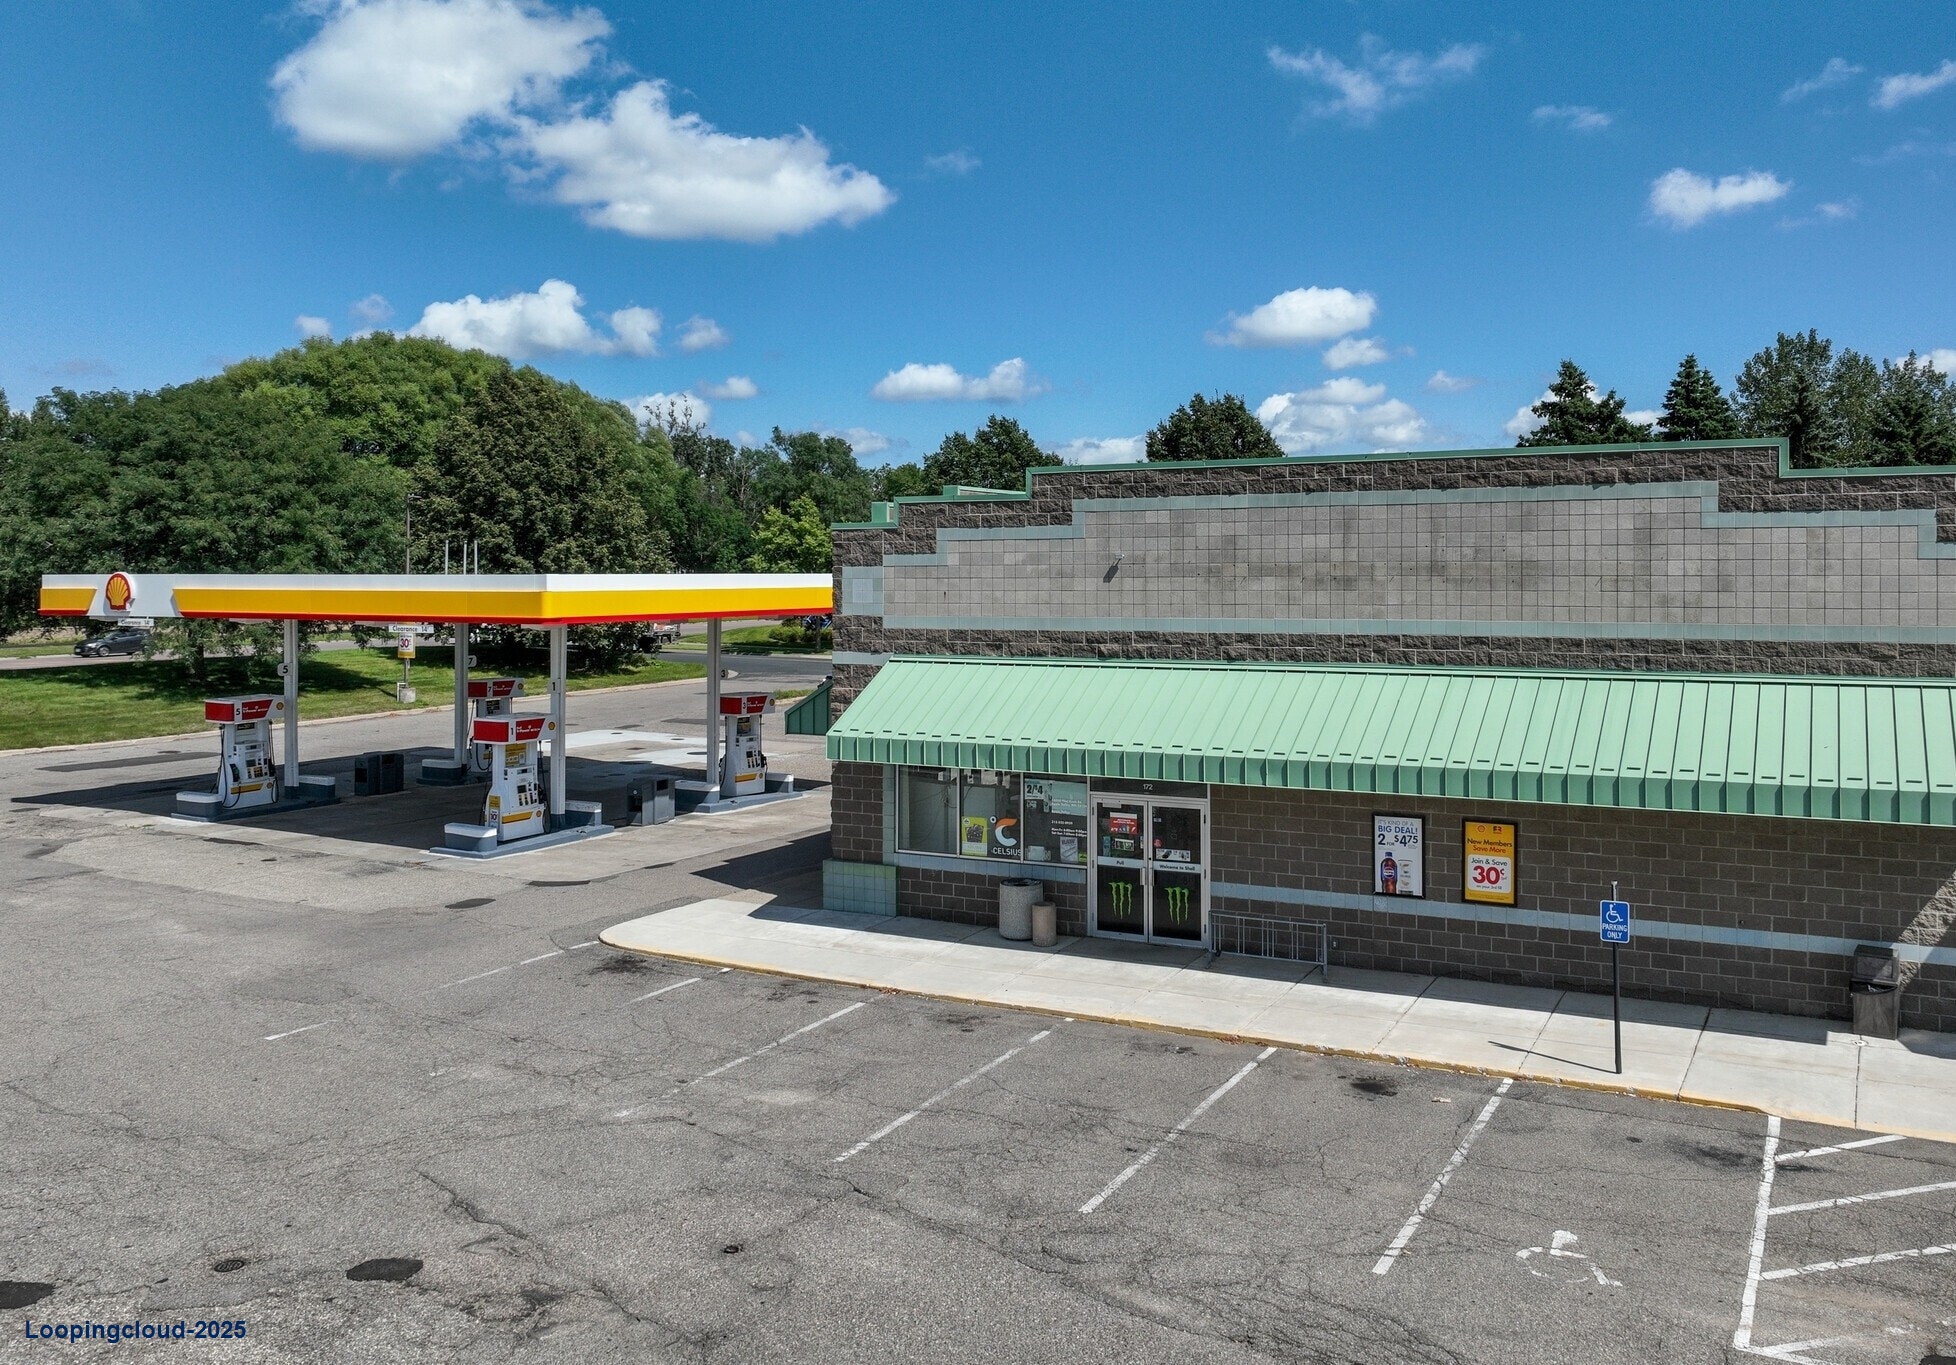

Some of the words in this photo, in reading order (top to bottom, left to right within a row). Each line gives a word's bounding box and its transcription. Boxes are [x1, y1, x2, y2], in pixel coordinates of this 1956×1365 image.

[282, 665, 288, 674] 5
[552, 682, 555, 691] 1
[1378, 834, 1386, 845] 2
[992, 848, 1021, 856] CELSIUS
[1602, 923, 1628, 932] PARKING
[1607, 931, 1622, 939] ONLY
